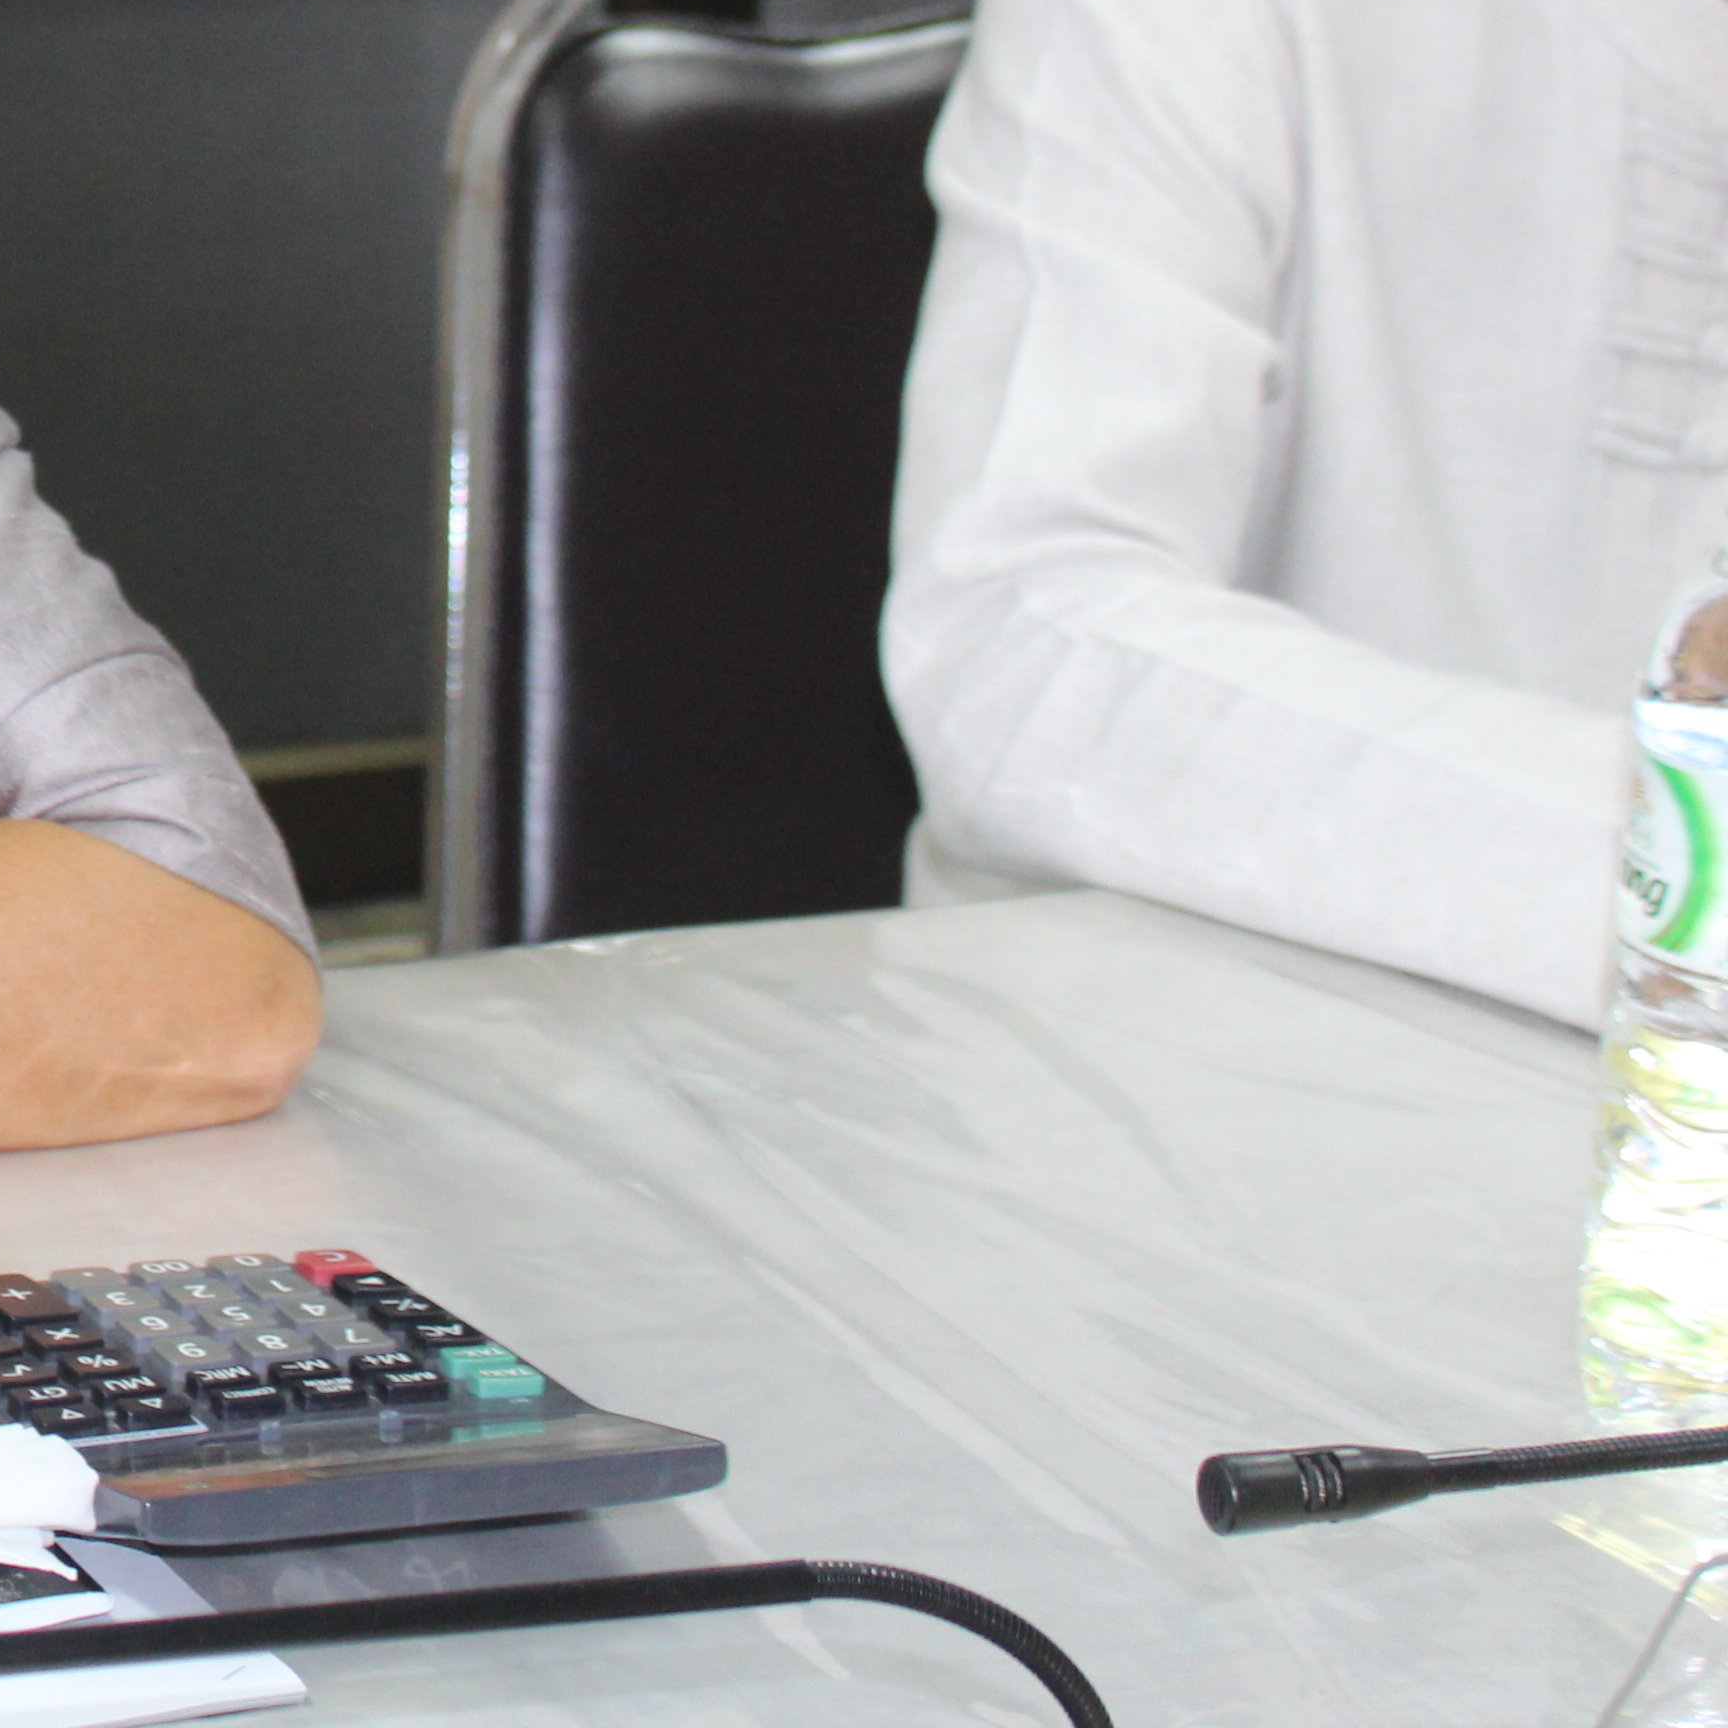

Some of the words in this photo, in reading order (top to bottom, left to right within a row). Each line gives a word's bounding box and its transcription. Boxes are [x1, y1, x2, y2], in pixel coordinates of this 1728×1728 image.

[416, 1323, 464, 1338] AC
[256, 1333, 290, 1351] 8
[194, 1365, 253, 1382] MRC
[385, 1370, 439, 1384] RATE
[103, 1374, 157, 1392] MU
[28, 1385, 69, 1402] GT
